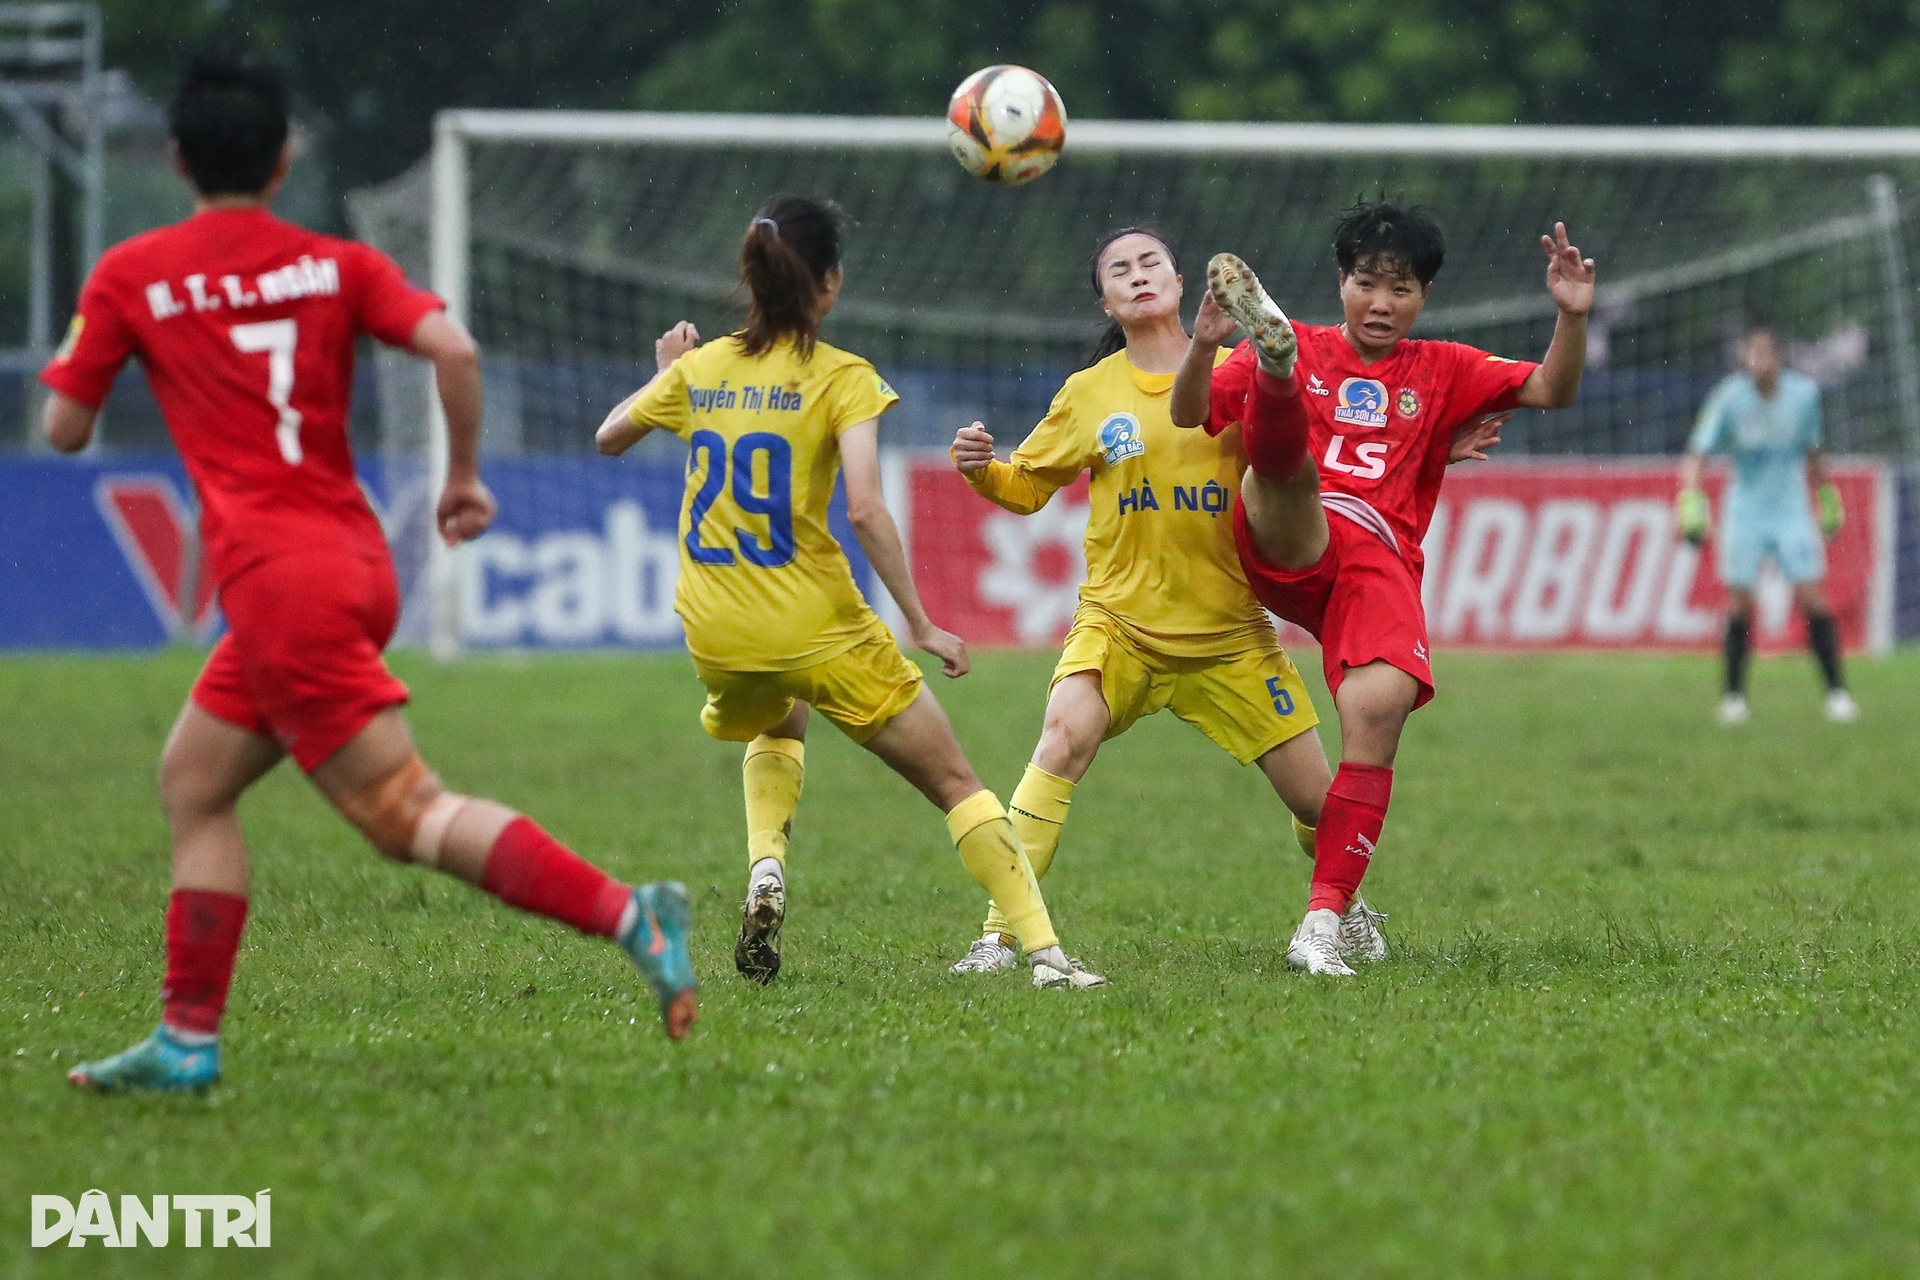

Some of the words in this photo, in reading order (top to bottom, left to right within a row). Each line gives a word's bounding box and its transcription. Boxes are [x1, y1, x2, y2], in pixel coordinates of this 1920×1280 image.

[228, 317, 303, 466] 7
[742, 386, 766, 415] Thị
[768, 385, 803, 411] Hoa
[1323, 434, 1389, 480] LS
[685, 428, 797, 568] 29
[1118, 477, 1160, 516] HÀ
[1173, 478, 1229, 518] NỘI
[1264, 675, 1295, 716] 5
